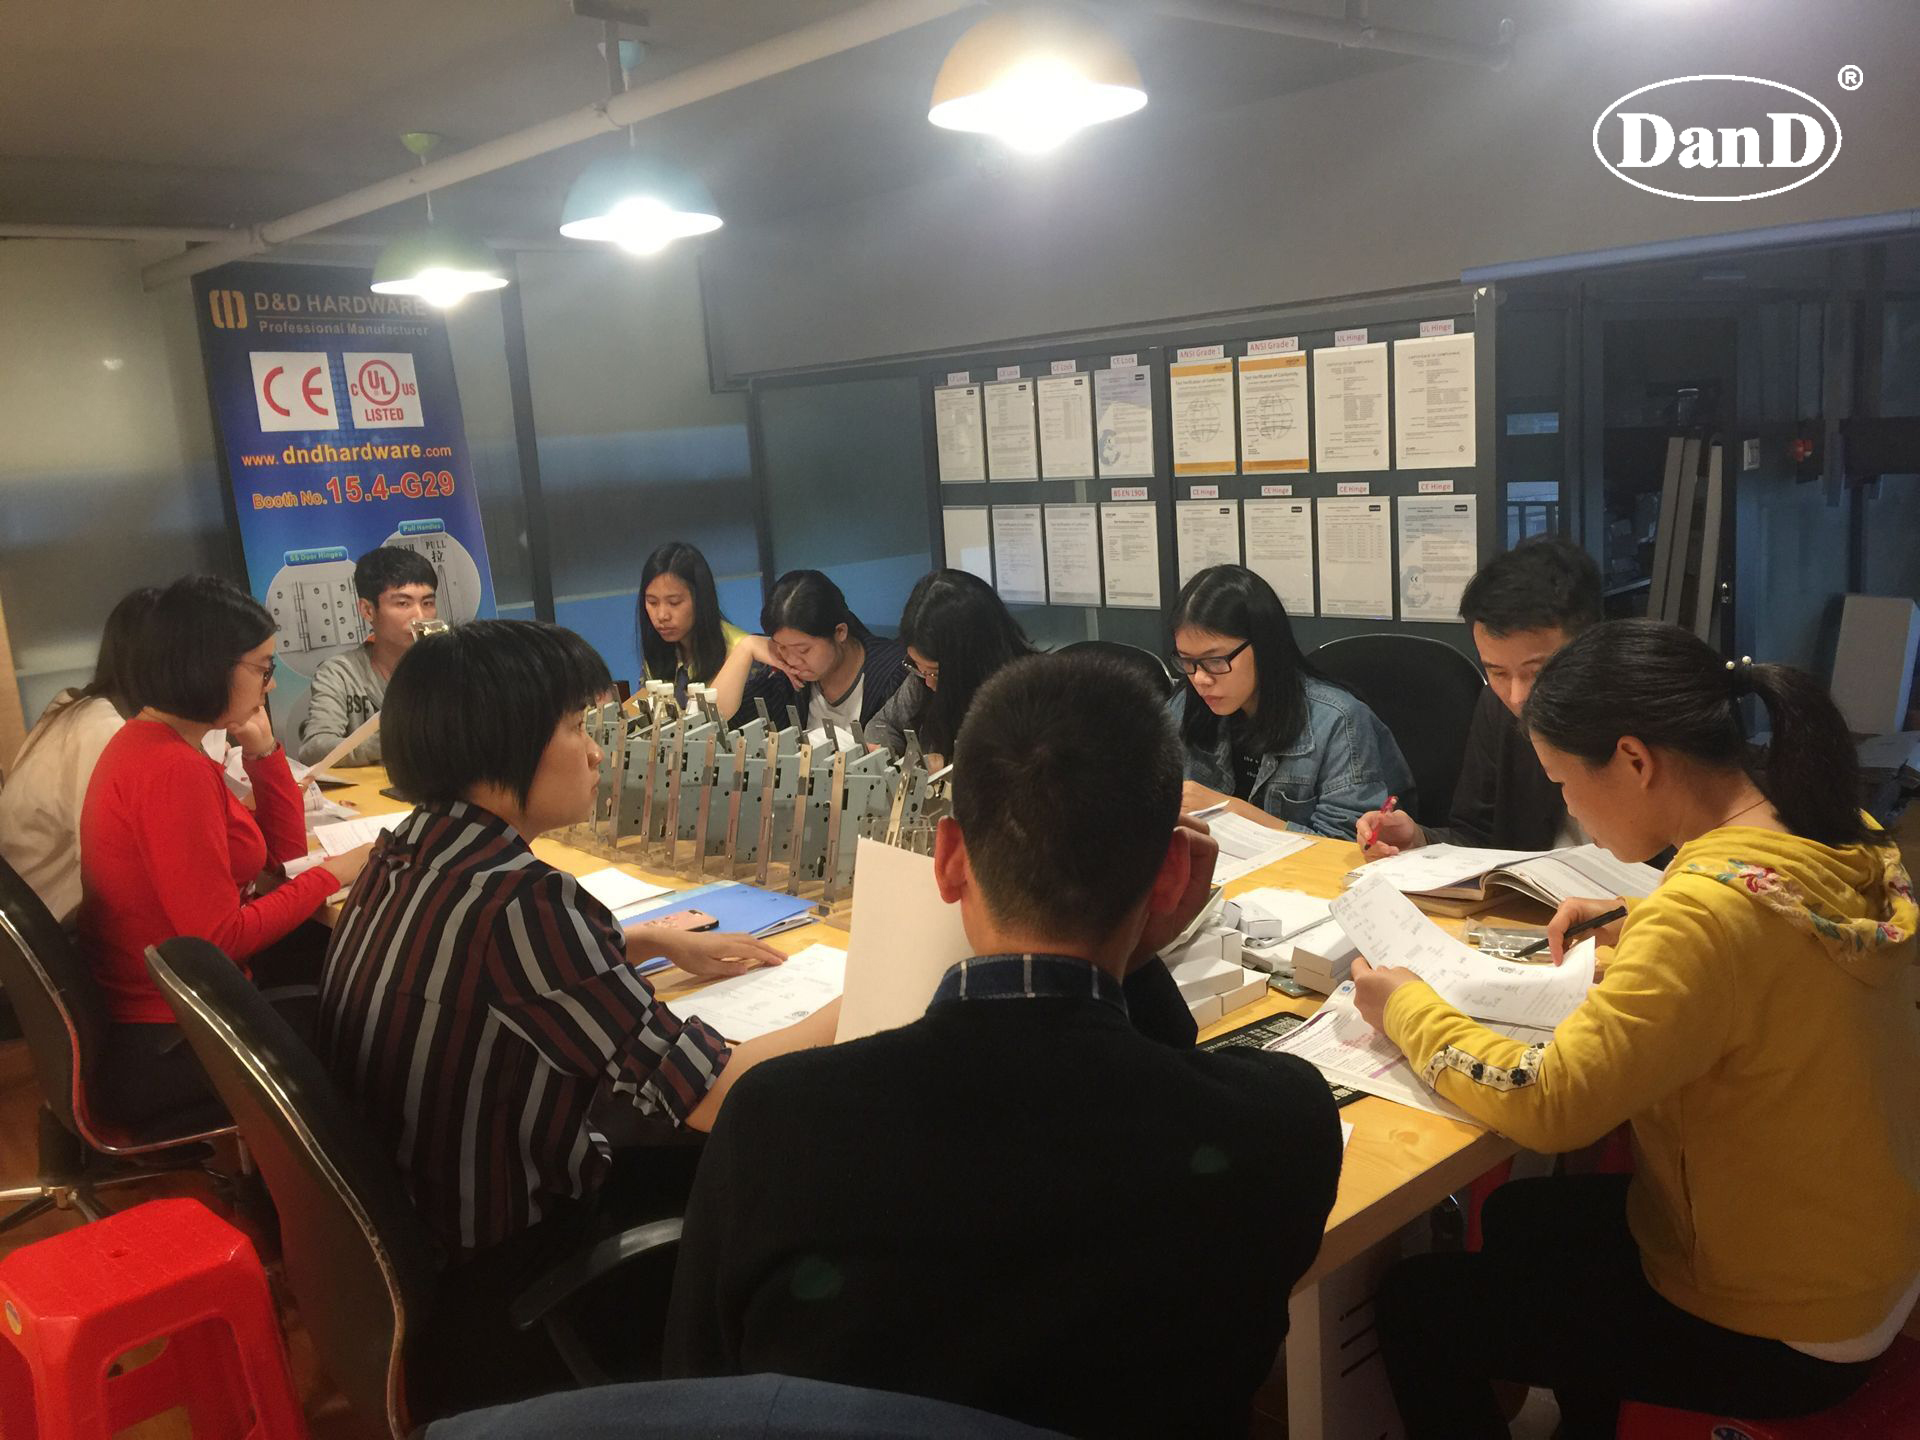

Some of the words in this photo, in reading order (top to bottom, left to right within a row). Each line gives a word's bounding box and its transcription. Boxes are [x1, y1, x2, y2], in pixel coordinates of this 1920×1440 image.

[254, 292, 300, 311] D&D
[307, 294, 428, 316] HARDWARE
[259, 320, 344, 334] Professional
[348, 323, 429, 336] Manufacturer
[1432, 324, 1451, 332] Hinge
[1347, 334, 1365, 343] Hinge
[1249, 342, 1266, 351] ANSI
[1267, 341, 1288, 350] Grade
[1180, 350, 1196, 358] ANSI
[1197, 348, 1216, 357] Grade
[367, 369, 392, 396] UL
[402, 383, 417, 396] US
[263, 366, 329, 417] CE
[364, 408, 404, 421] LISTED
[252, 492, 298, 509] Booth
[300, 491, 328, 506] No.
[326, 470, 455, 504] 15.4-G29
[1131, 488, 1146, 496] 1906
[1272, 487, 1289, 495] Hinge
[1348, 486, 1367, 494] Hinge
[1431, 483, 1451, 491] Hinge
[1200, 488, 1216, 497] Hinge
[425, 539, 446, 550] PULL
[431, 550, 446, 563] 拉
